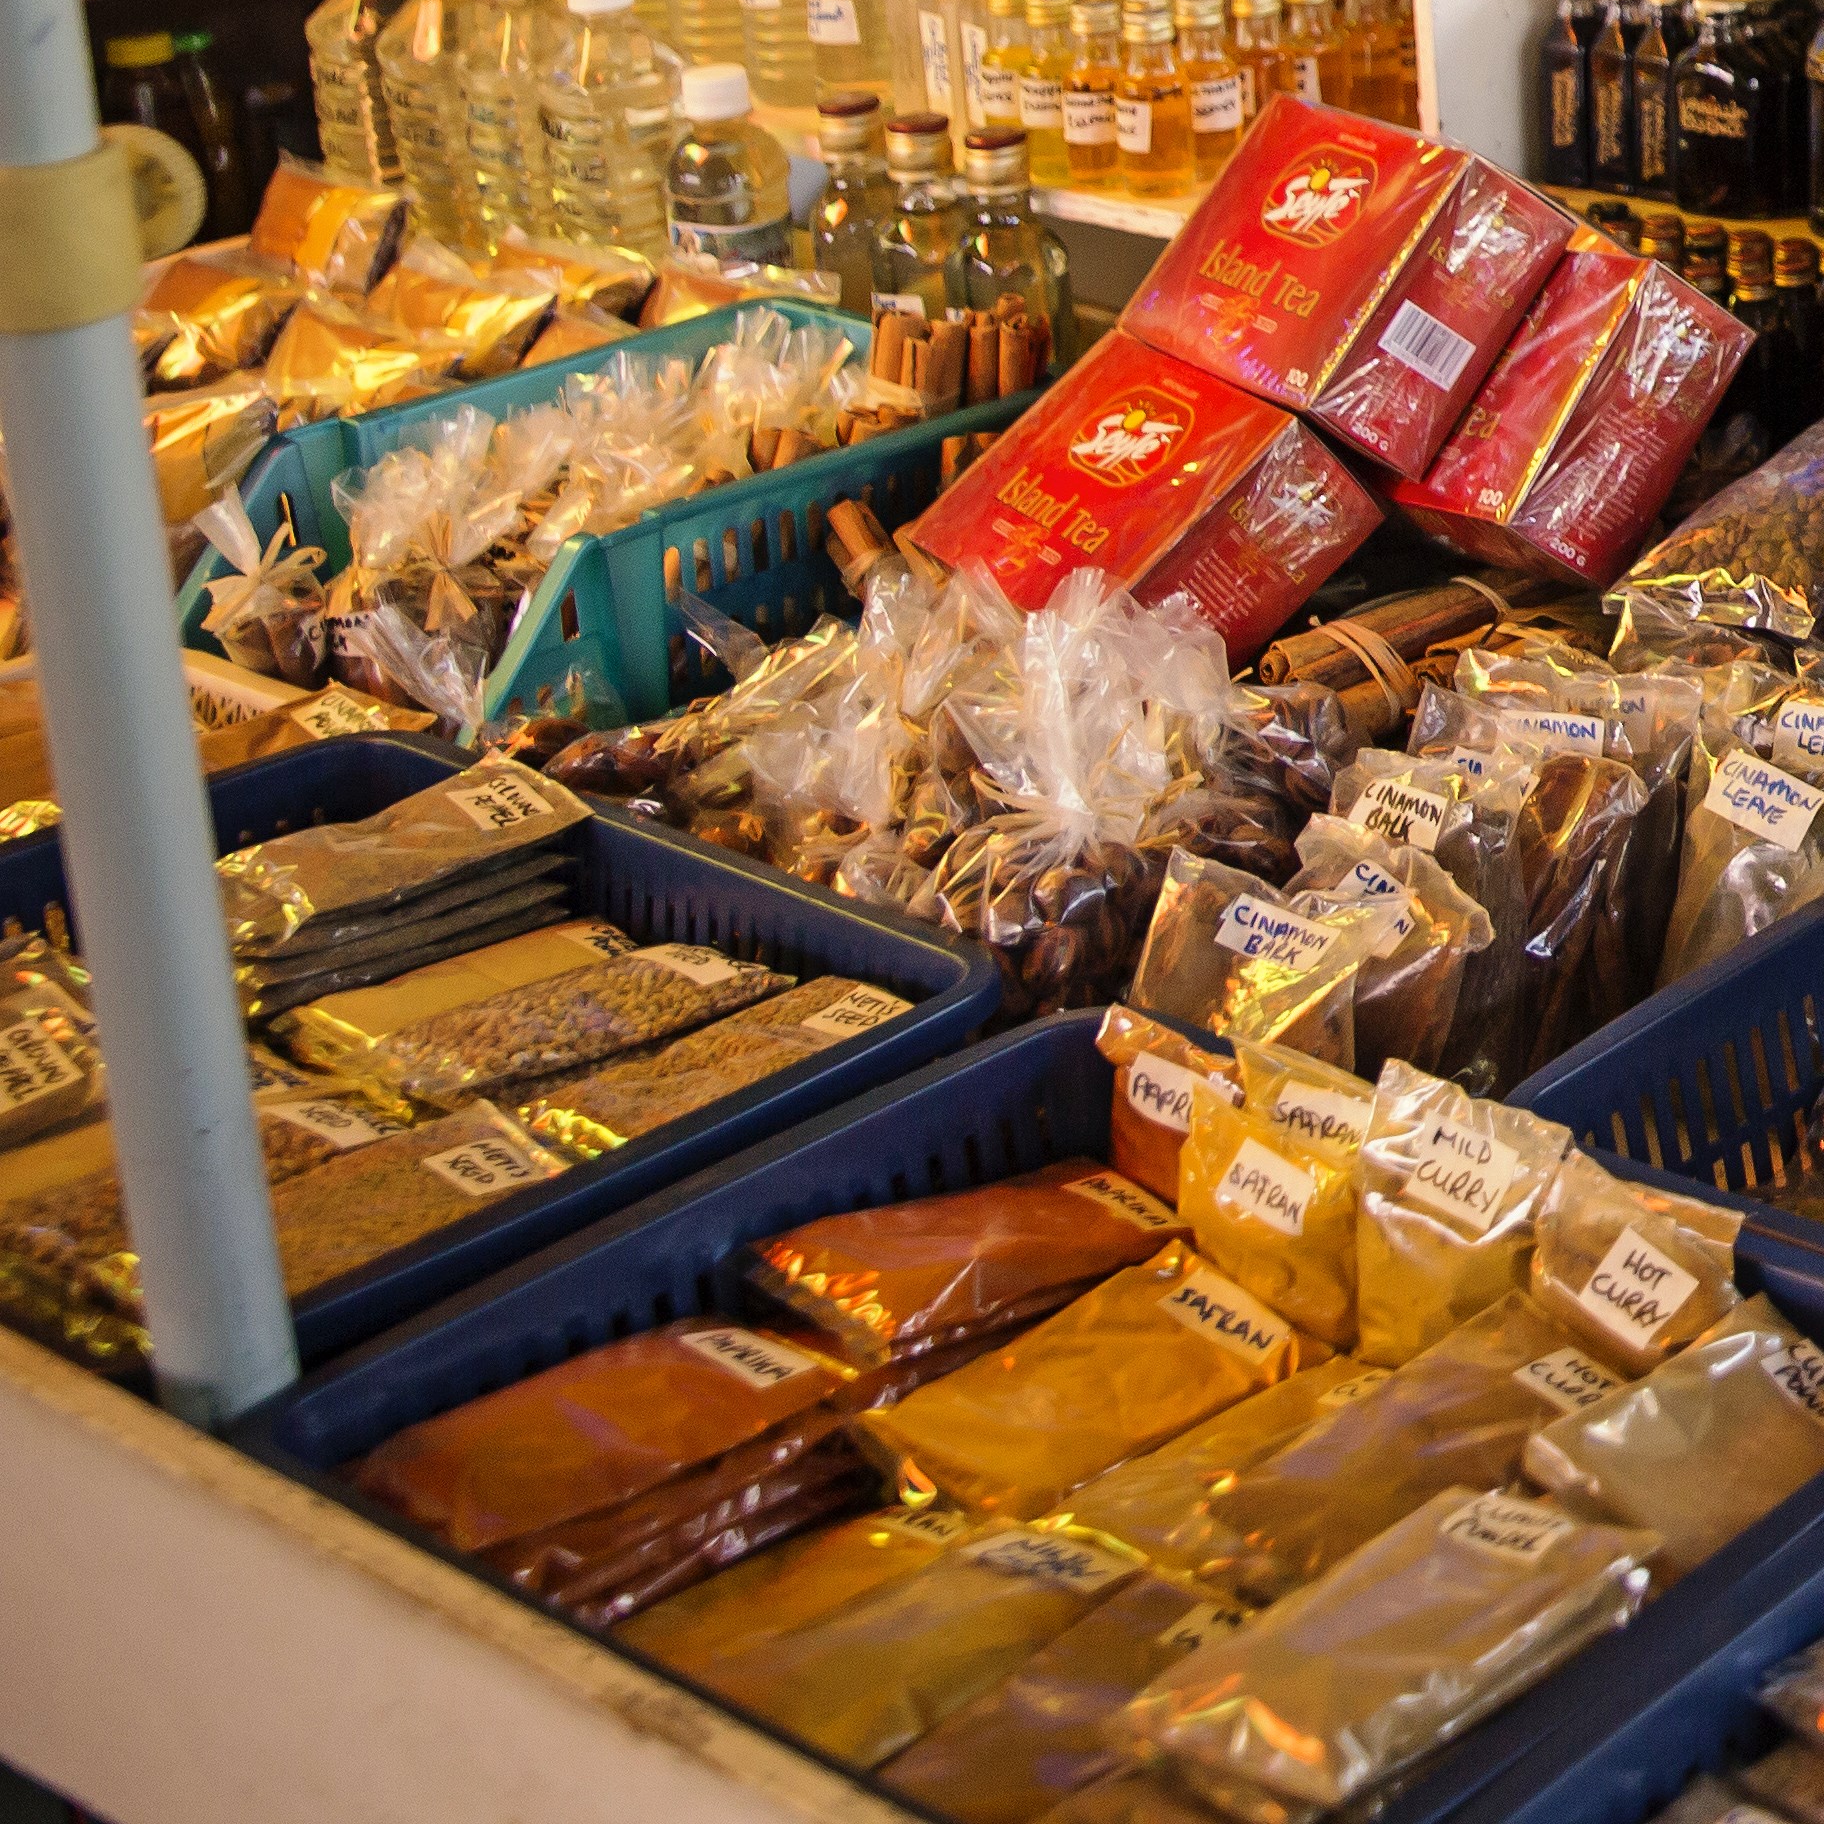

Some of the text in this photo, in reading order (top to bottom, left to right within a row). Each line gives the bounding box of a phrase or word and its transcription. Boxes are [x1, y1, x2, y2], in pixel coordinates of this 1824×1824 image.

[1199, 238, 1320, 319] Island Tea
[996, 465, 1111, 556] Island Tea
[1432, 1124, 1495, 1167] MILD
[1415, 1161, 1497, 1216] CURRY
[1621, 1247, 1666, 1290] HOT
